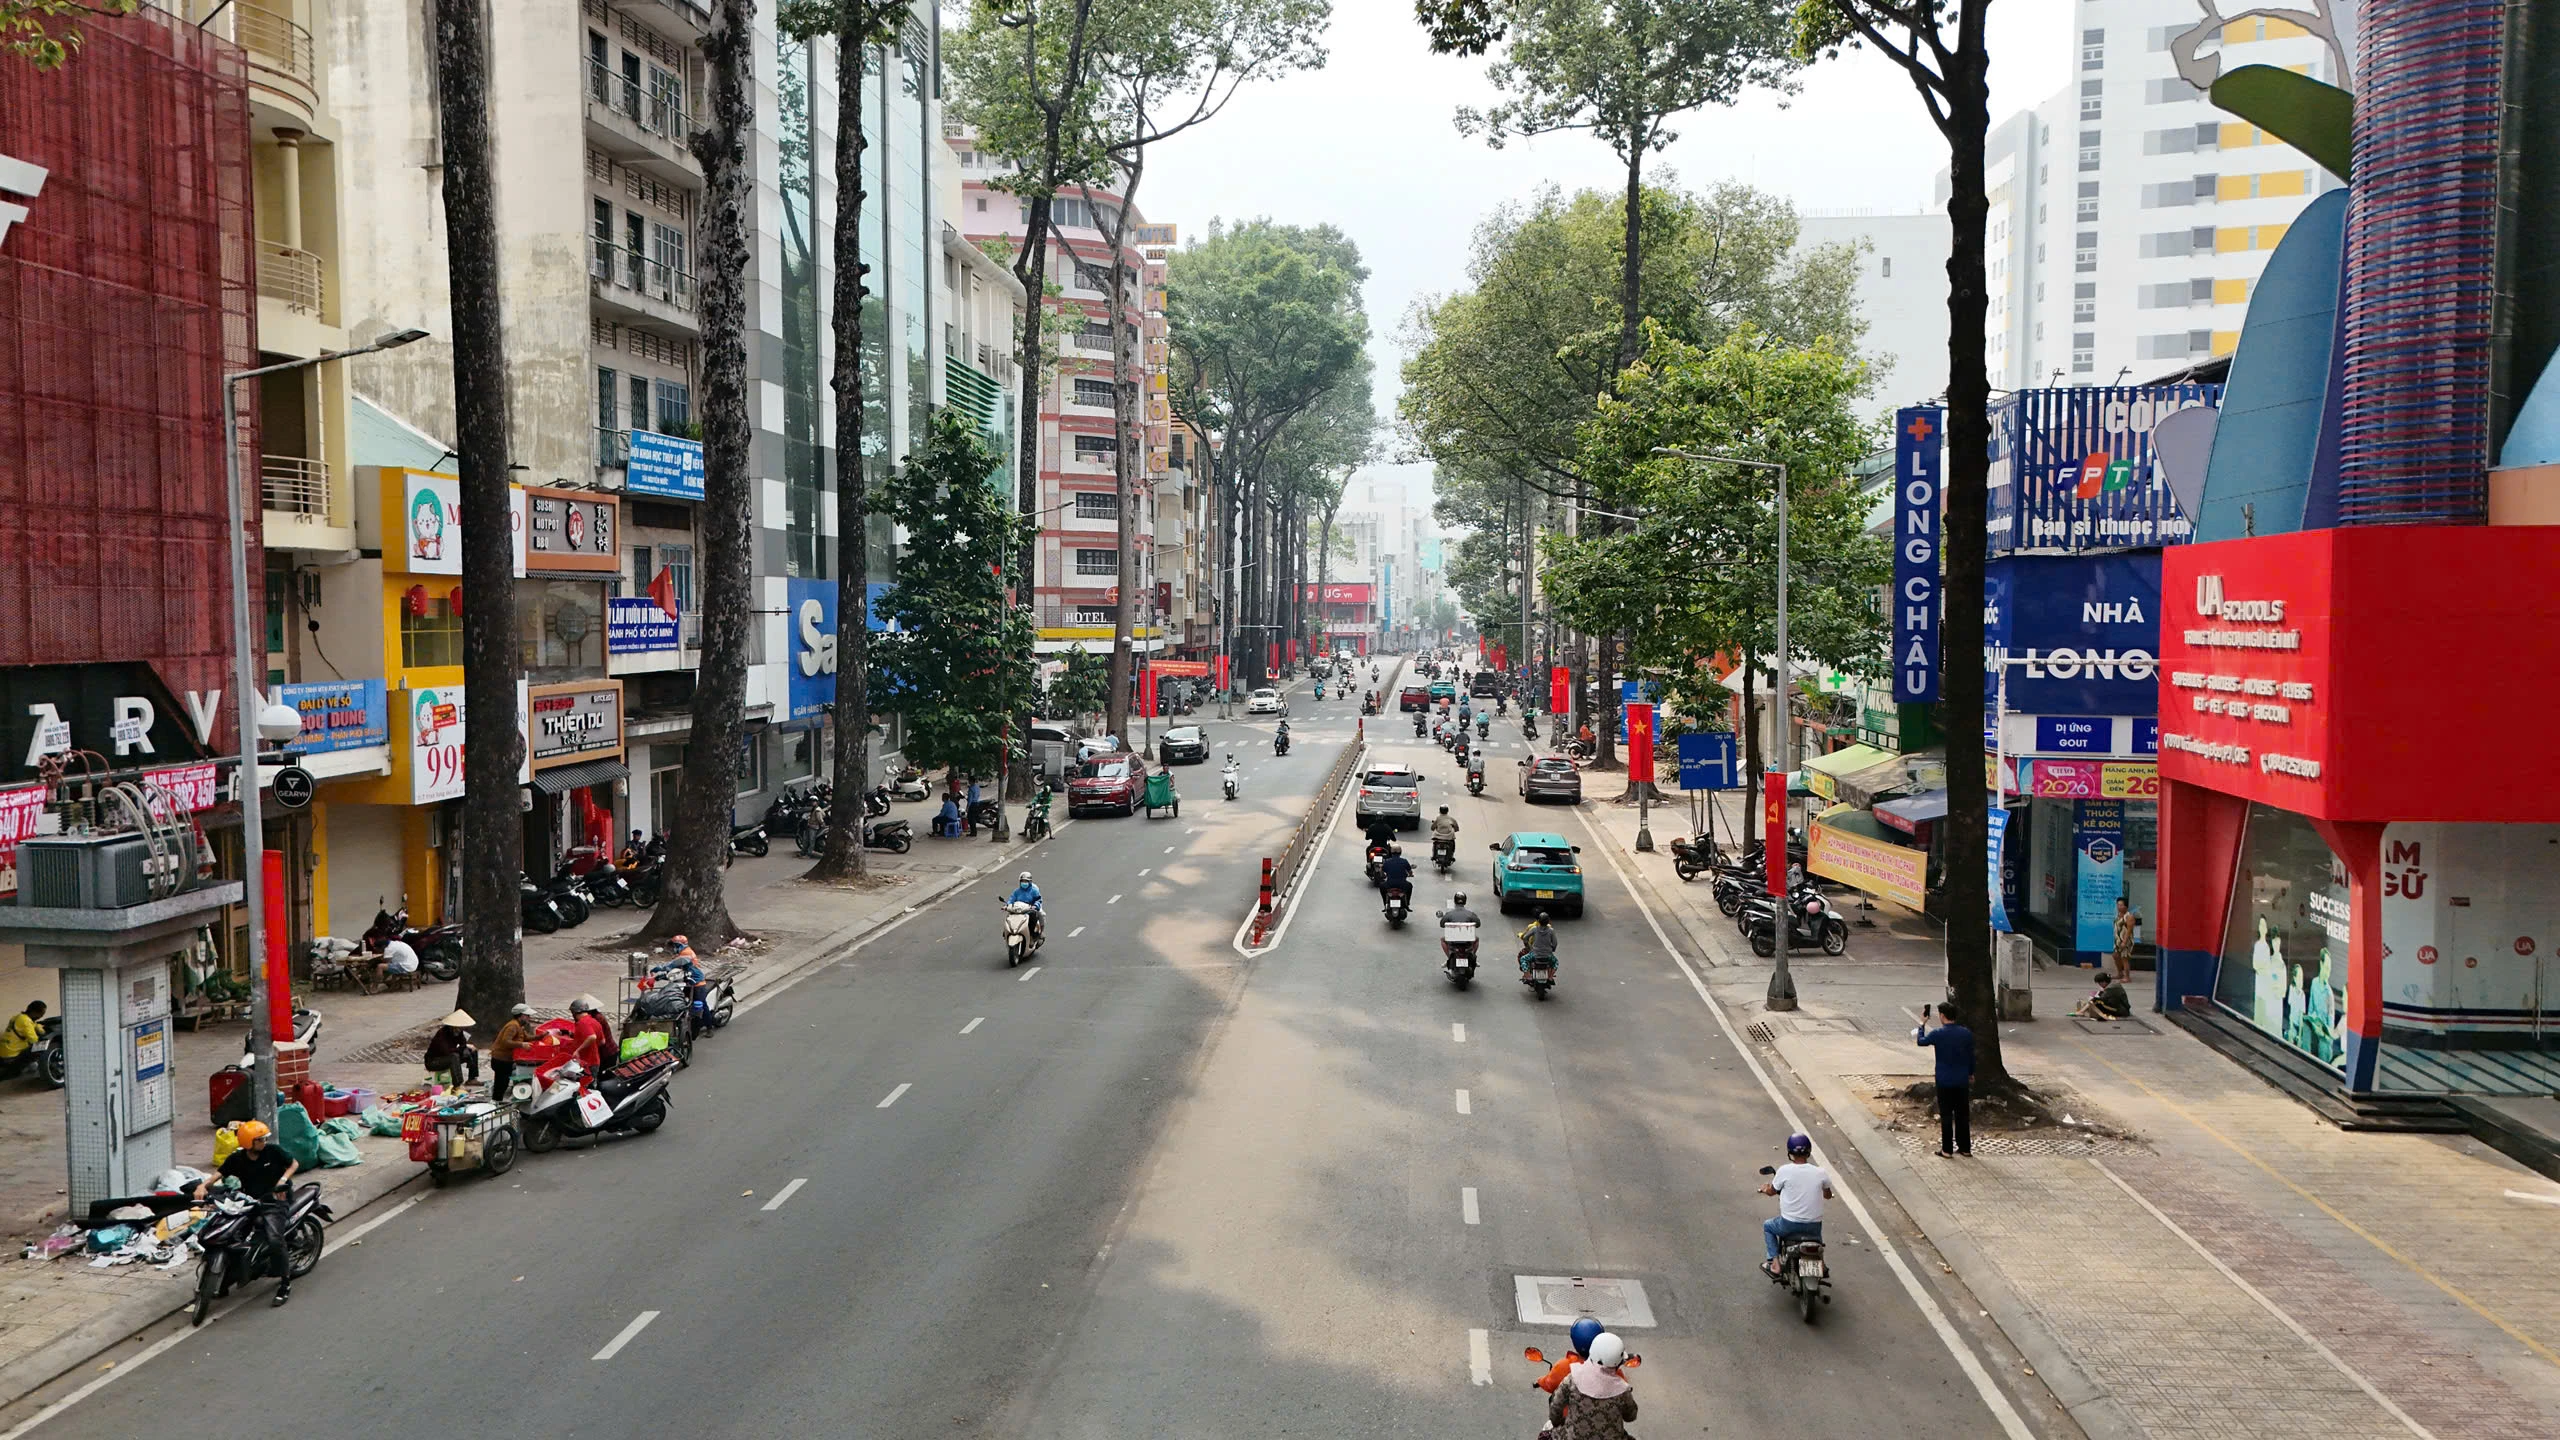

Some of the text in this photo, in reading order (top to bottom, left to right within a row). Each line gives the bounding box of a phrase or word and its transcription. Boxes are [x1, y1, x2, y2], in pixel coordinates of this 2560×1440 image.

[536, 500, 555, 512] SUSHI
[1905, 451, 1932, 563] LONG
[536, 518, 559, 530] HOTPOT
[2032, 515, 2066, 536] Bán
[2100, 513, 2153, 536] thuốc
[536, 536, 549, 549] BBQ
[2197, 576, 2284, 622] UA SCHOOLS
[1065, 612, 1107, 623] HOTEL
[2083, 596, 2145, 623] NHÀ
[608, 625, 673, 638] HÀNH PHỐ HỒ CHÍ MINH
[1905, 576, 1932, 695] CHÂU
[2026, 648, 2154, 680] LONG
[300, 700, 316, 712] ĐẠI
[317, 696, 325, 708] LÝ
[300, 710, 366, 733] GỌC DUNG
[2055, 722, 2092, 734] DỊ ỨNG
[2059, 739, 2088, 747] GOUT
[2043, 779, 2089, 795] 2026
[2085, 807, 2119, 817] THUỐC
[2310, 891, 2351, 921] SUCCESS
[2310, 912, 2350, 943] starts HERE
[2418, 950, 2435, 960] UA
